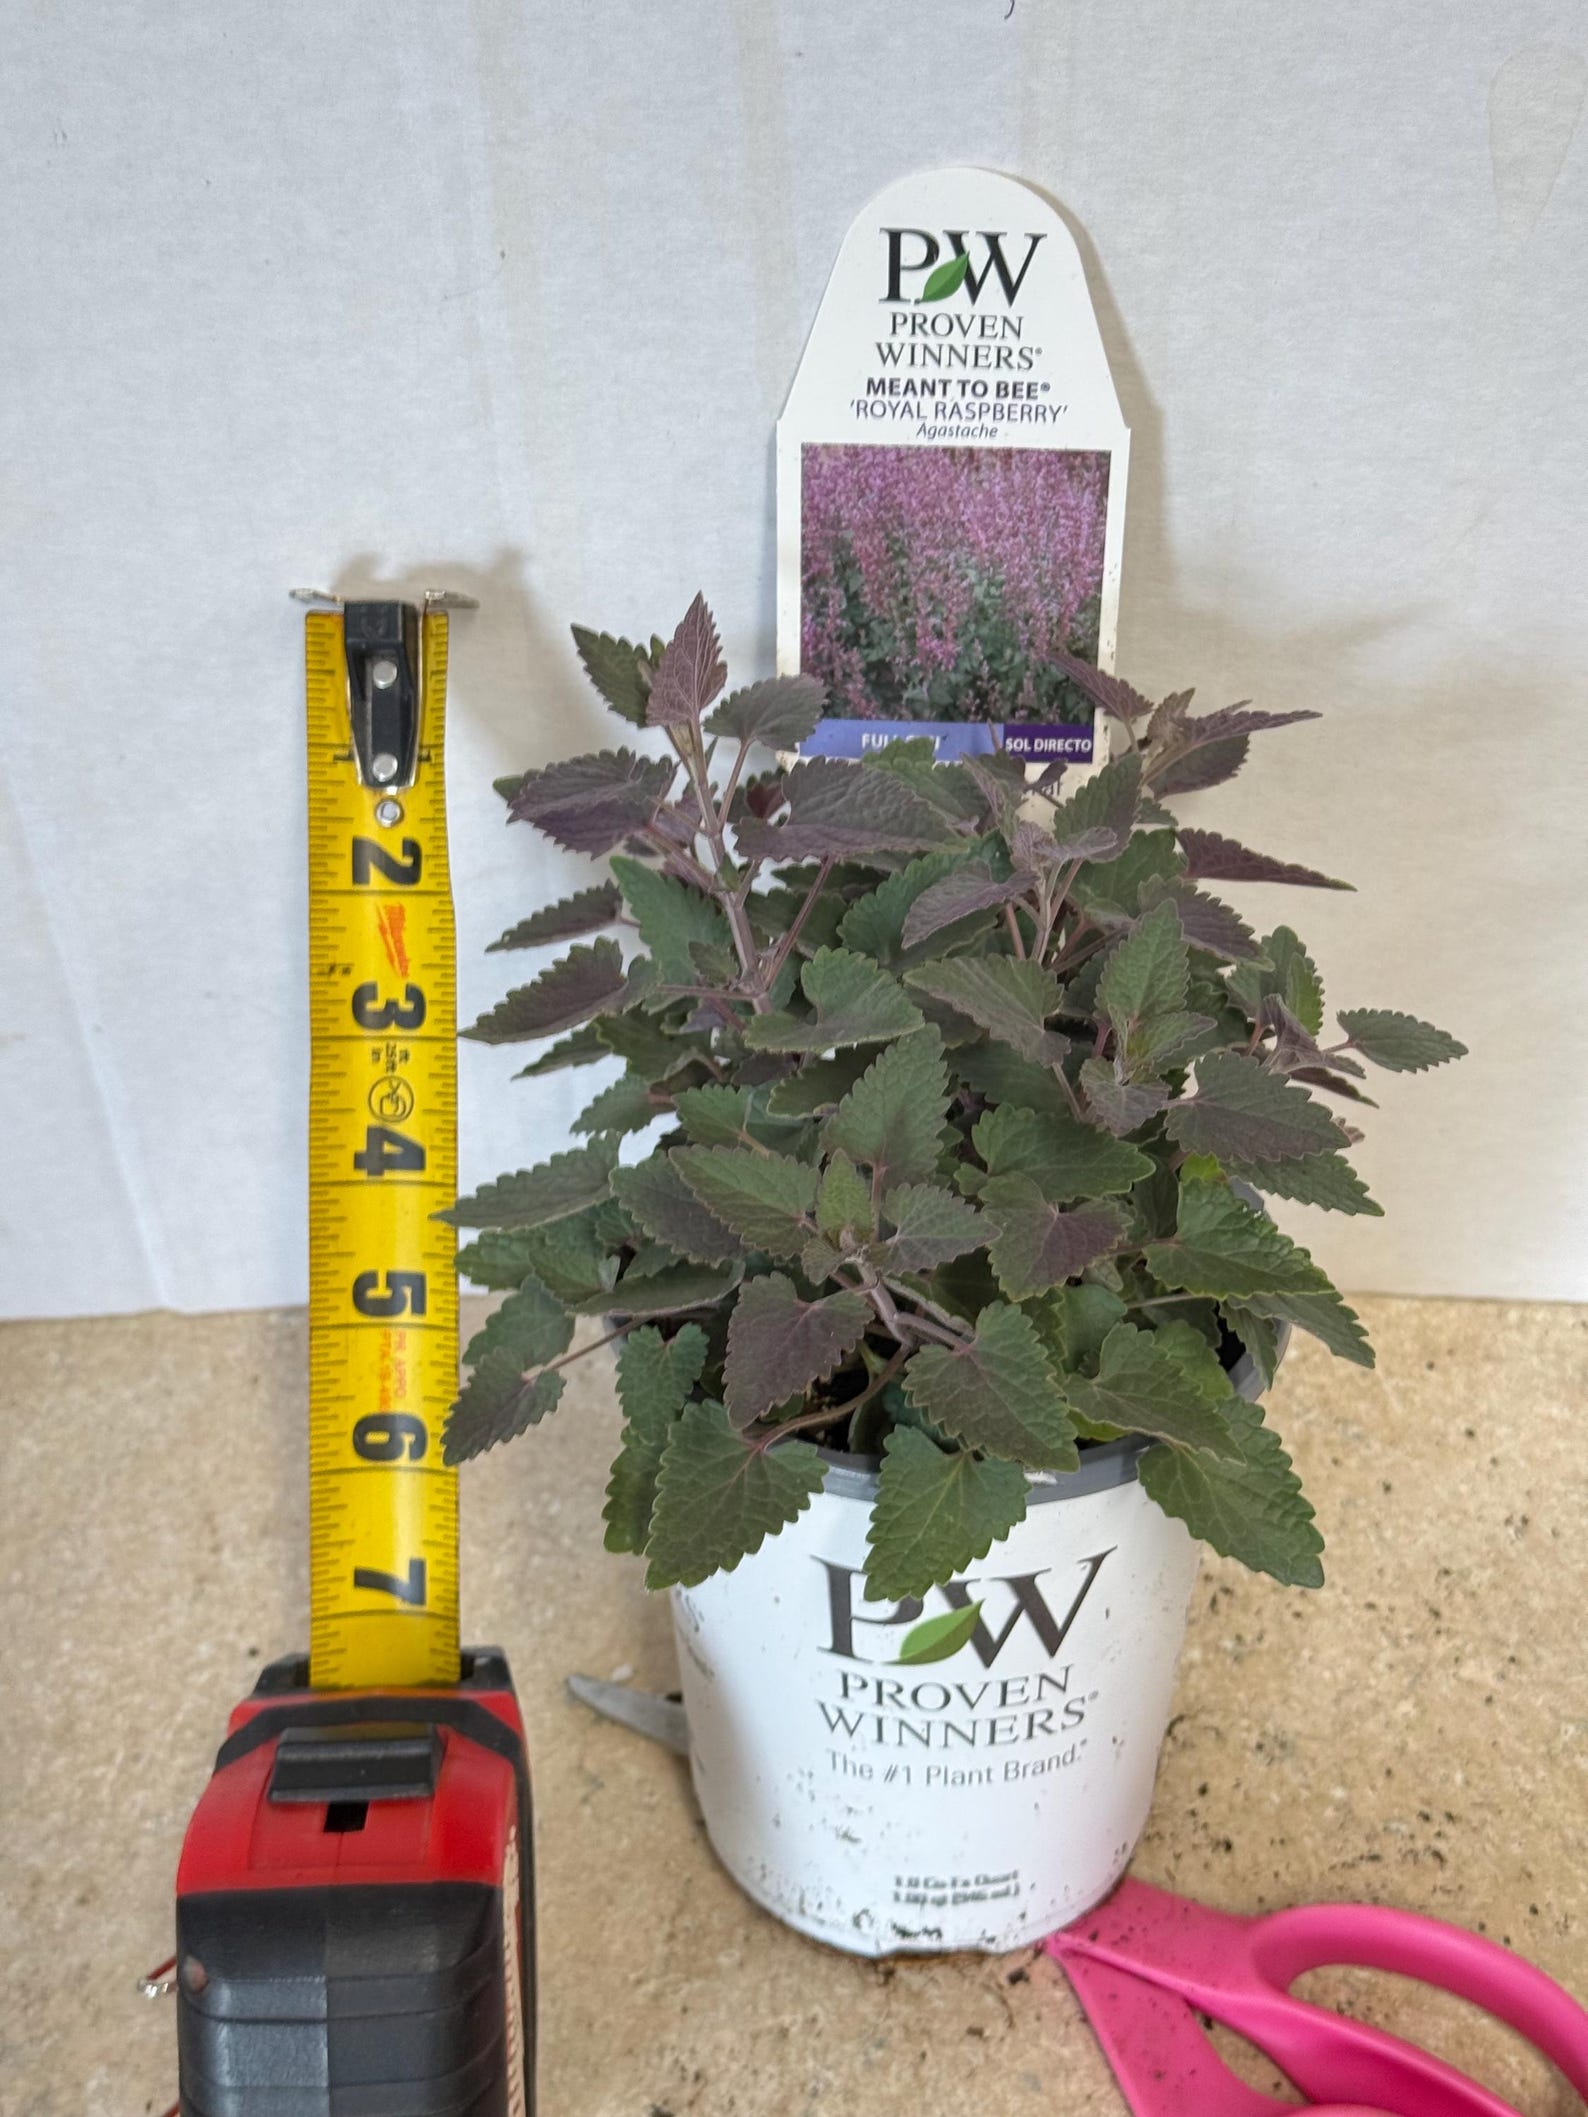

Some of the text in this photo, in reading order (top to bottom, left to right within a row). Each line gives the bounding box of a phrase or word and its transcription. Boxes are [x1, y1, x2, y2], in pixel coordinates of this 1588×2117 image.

[878, 227, 1048, 308] PW
[888, 311, 1024, 341] PROVEN
[866, 377, 952, 398] MEANT
[957, 379, 988, 399] TO
[916, 422, 998, 440] Agastache
[1005, 737, 1092, 754] SOL DIRECTO
[352, 836, 422, 887] 2
[351, 981, 426, 1031] 3
[353, 1125, 426, 1177] 4
[351, 1269, 427, 1318] 5
[351, 1411, 428, 1463] 6
[353, 1557, 427, 1607] 7
[839, 1663, 1075, 1713] PROVEN
[826, 1748, 874, 1781] The
[883, 1764, 912, 1787] #1
[925, 1764, 993, 1787] Plant
